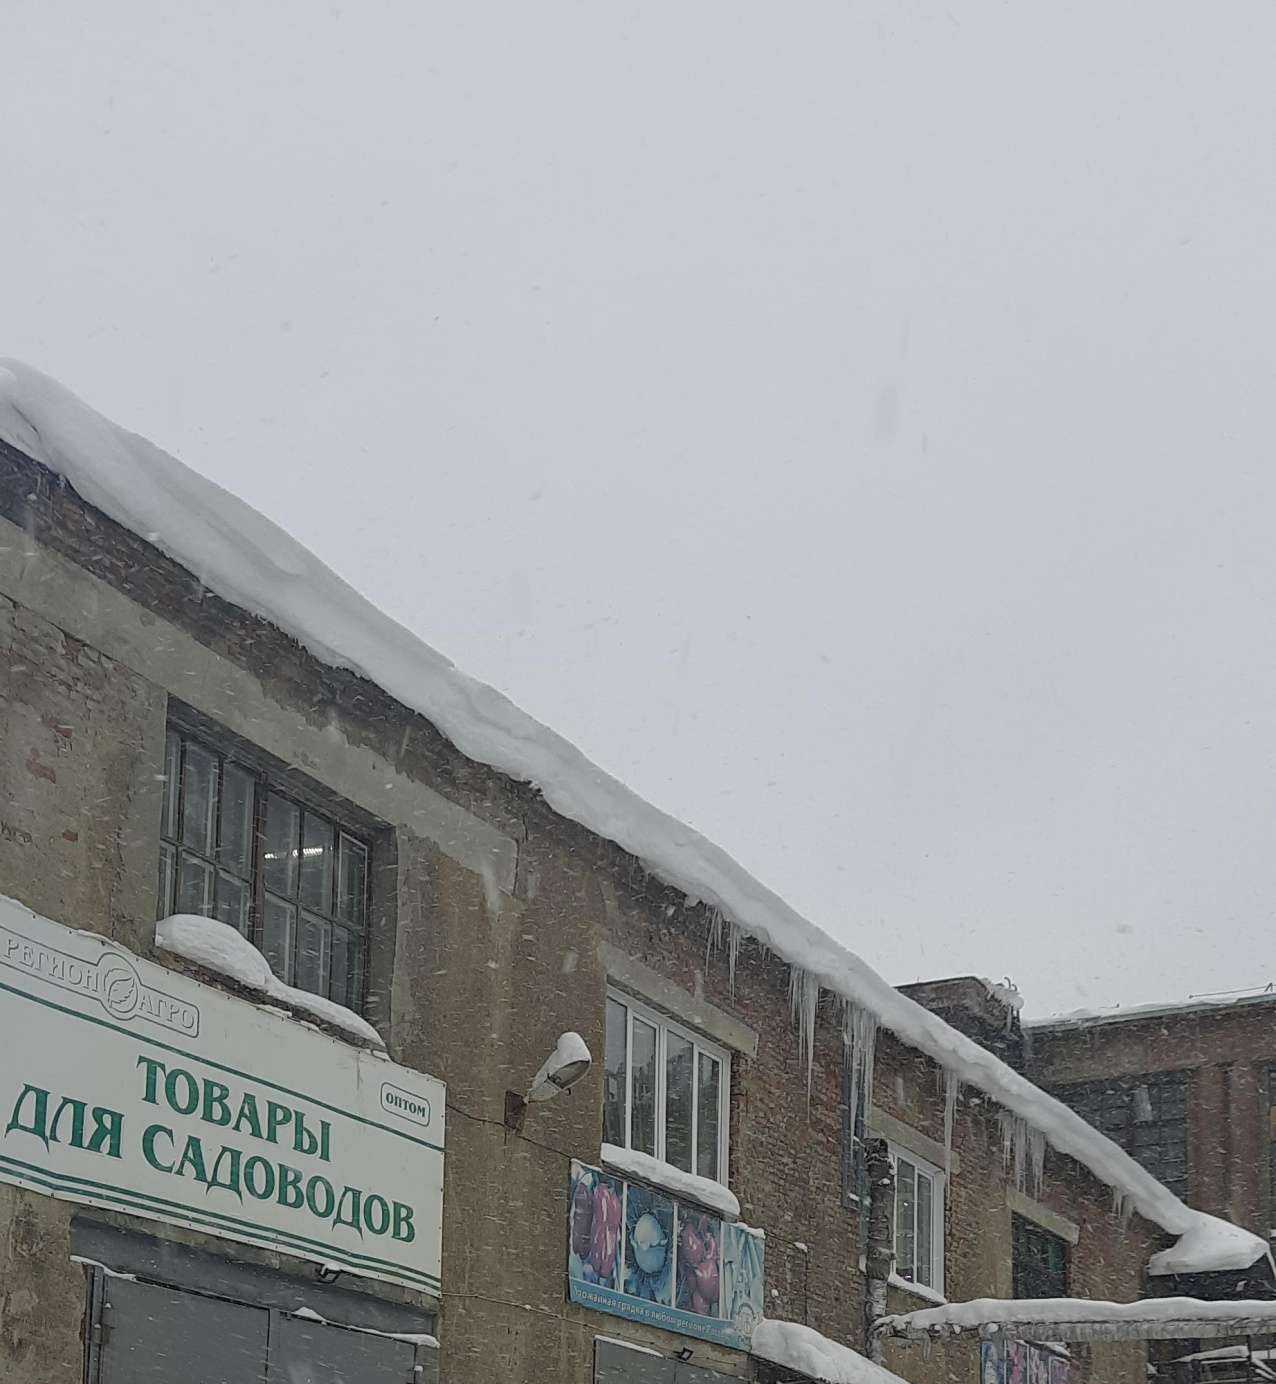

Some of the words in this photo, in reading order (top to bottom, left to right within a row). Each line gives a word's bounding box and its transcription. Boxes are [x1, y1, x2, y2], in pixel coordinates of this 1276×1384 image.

[138, 994, 195, 1029] АГРО
[136, 1054, 332, 1163] ТОВАРЫ
[4, 1083, 125, 1159] ДЛЯ
[141, 1123, 417, 1245] САДОВОДОВ
